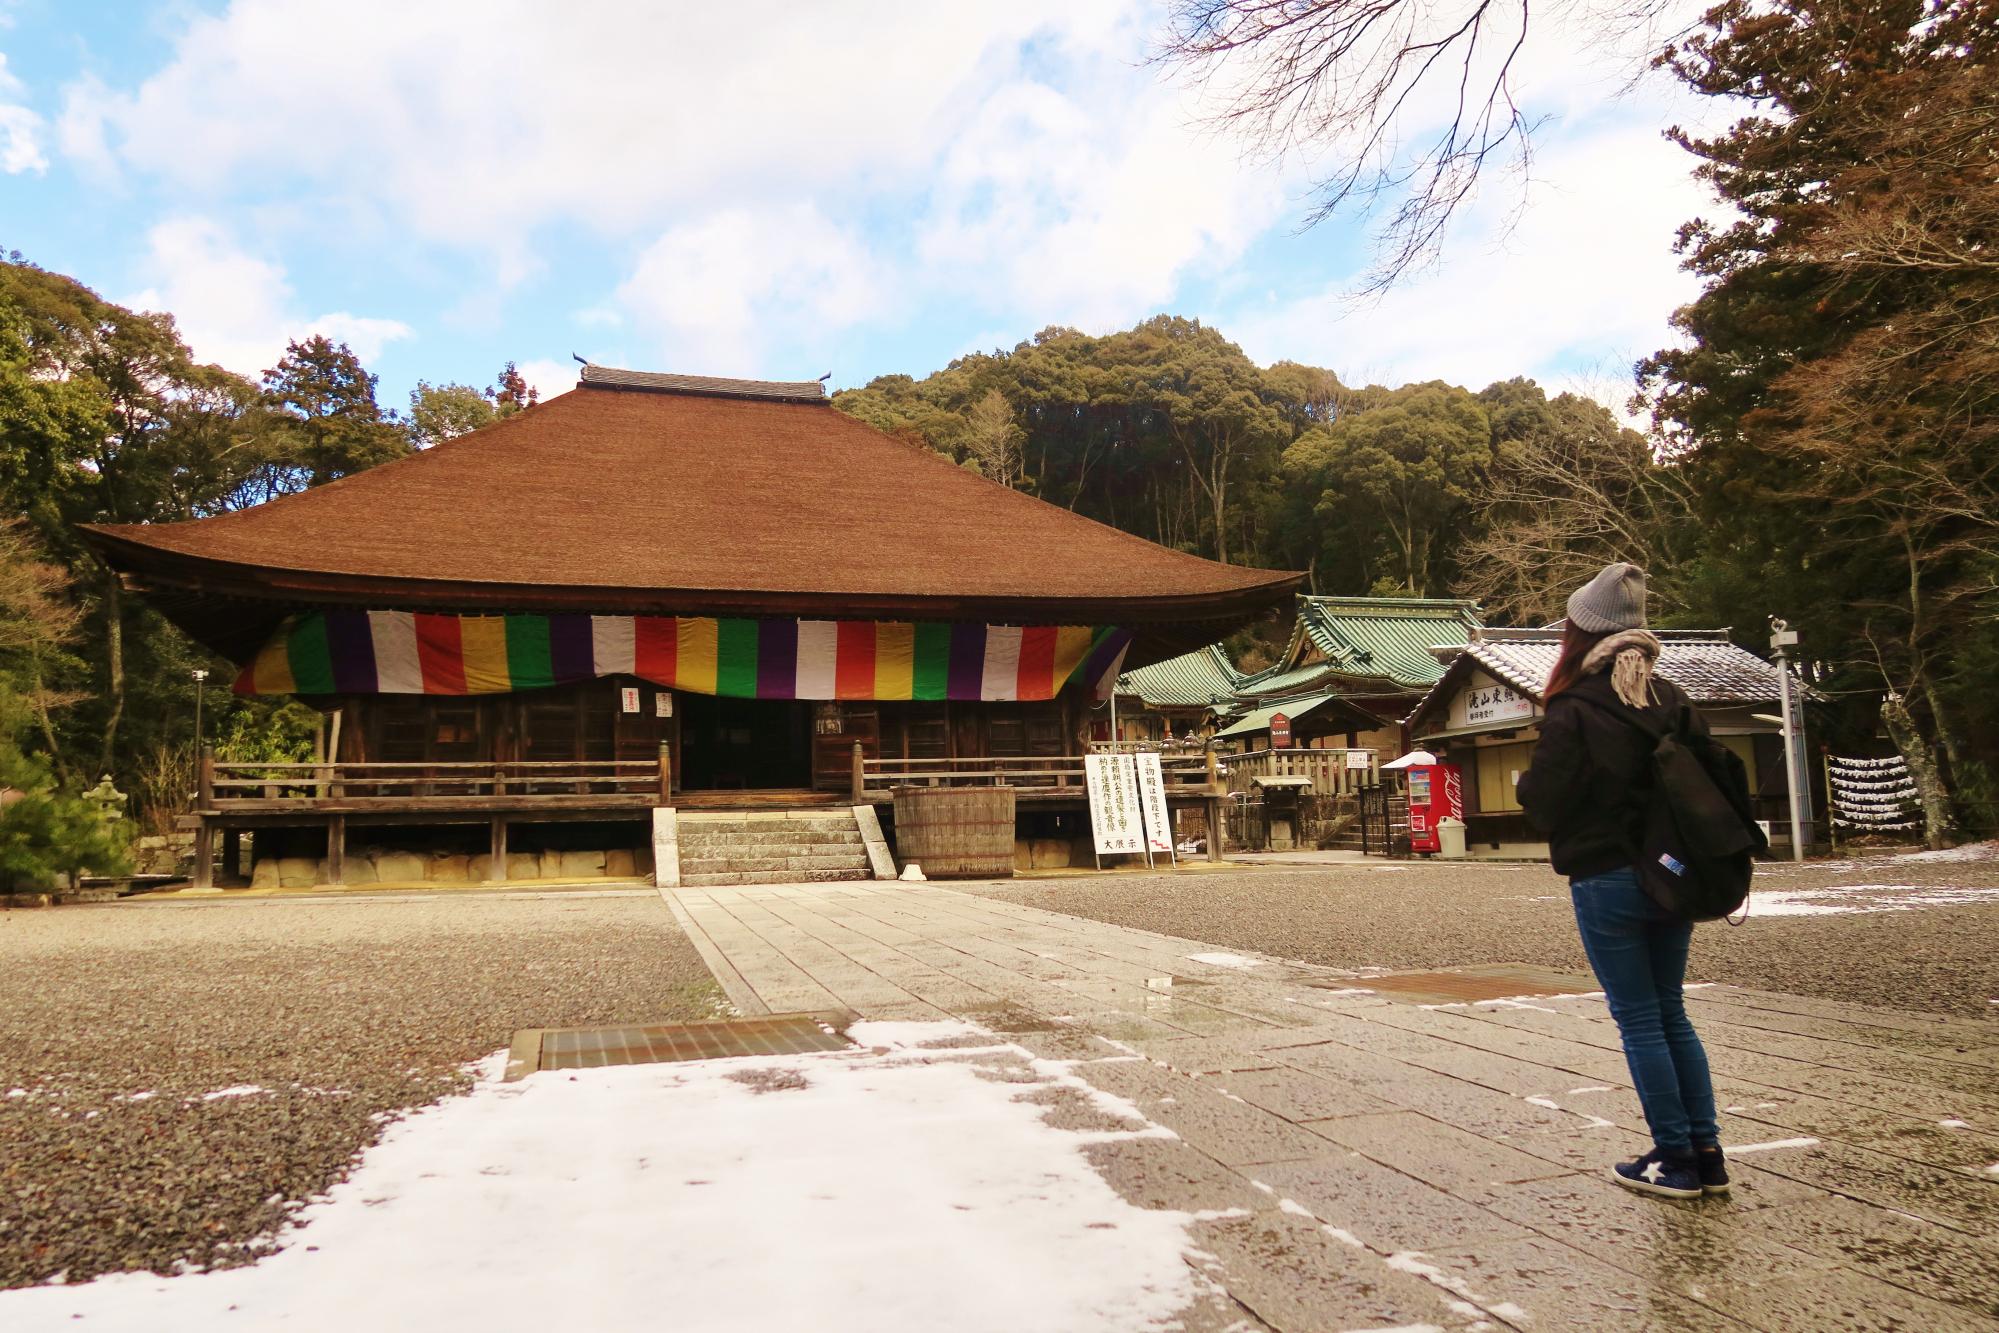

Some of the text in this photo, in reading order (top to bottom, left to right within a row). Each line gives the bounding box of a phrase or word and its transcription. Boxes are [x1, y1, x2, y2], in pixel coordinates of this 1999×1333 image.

[1469, 687, 1524, 709] 滝山東照
[1143, 757, 1163, 837] 宝物殿は階段下です
